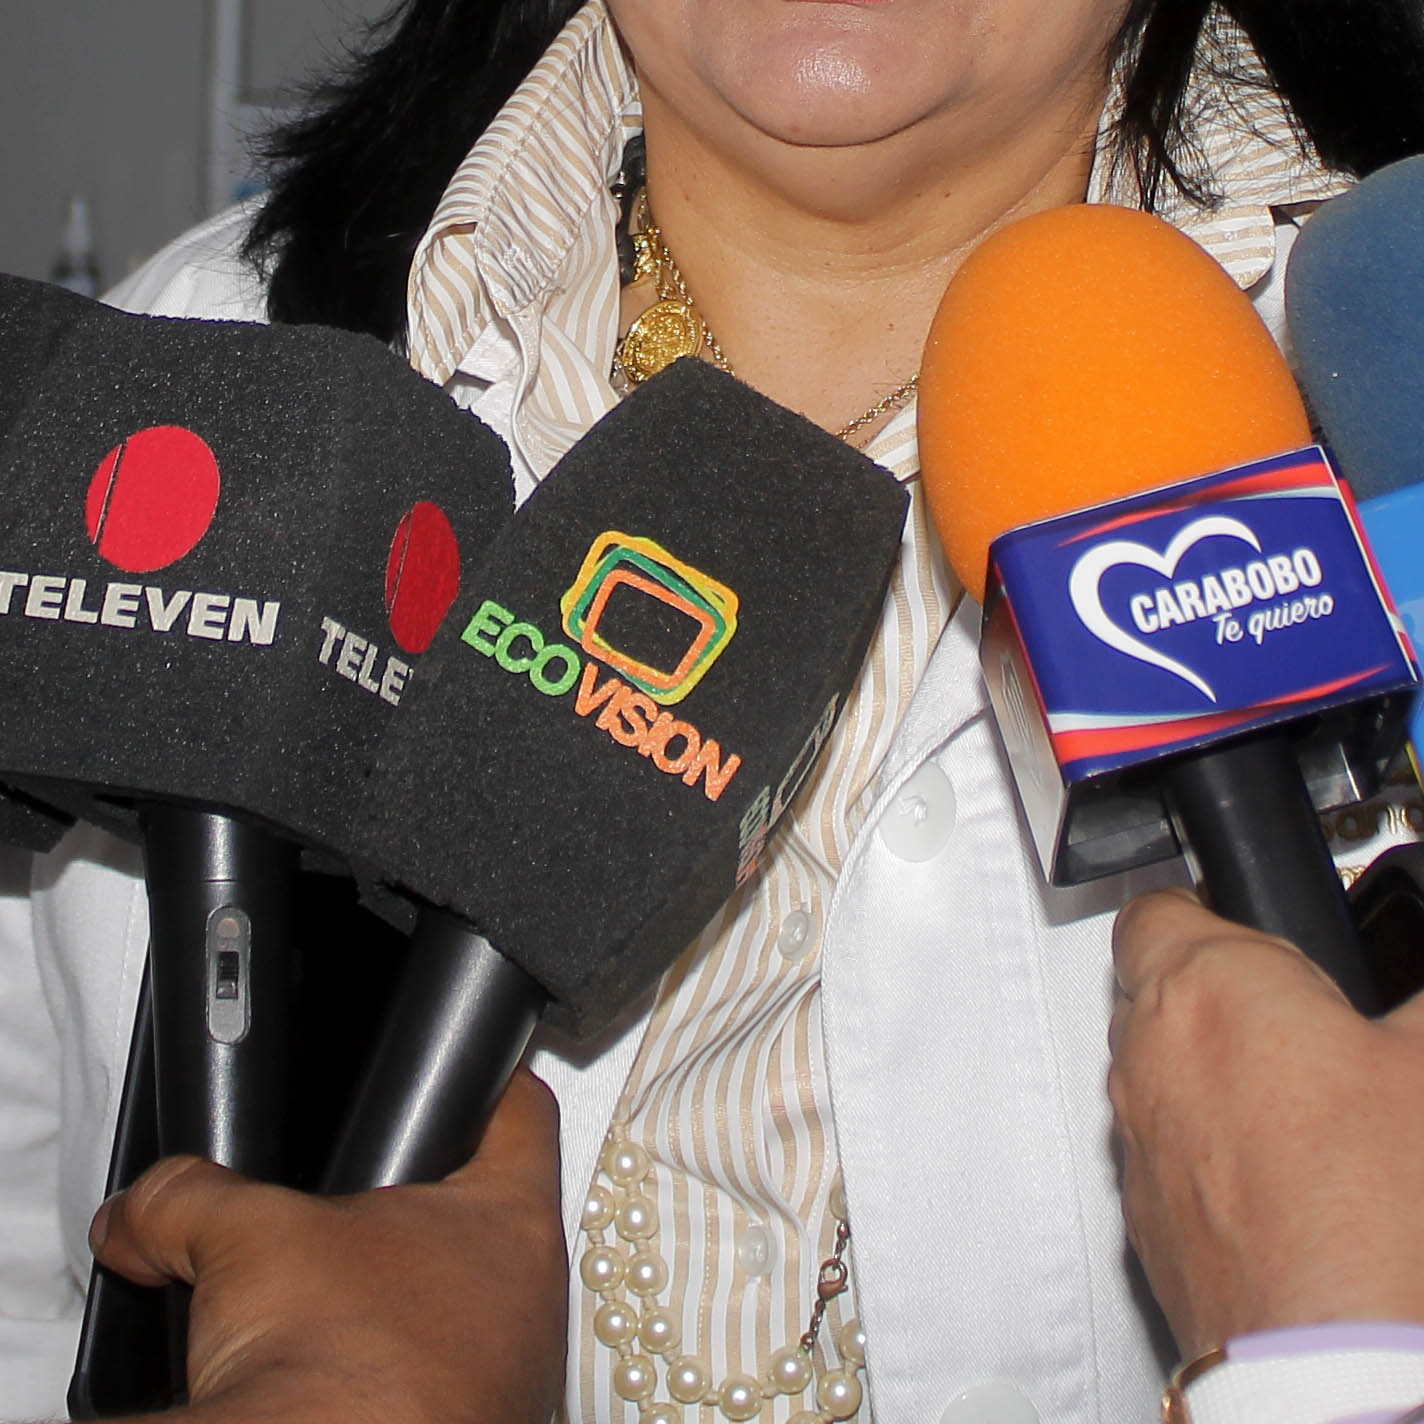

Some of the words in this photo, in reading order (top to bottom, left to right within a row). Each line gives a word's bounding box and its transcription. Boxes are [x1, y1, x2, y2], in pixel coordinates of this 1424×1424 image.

[1129, 548, 1324, 634] CARABOBO
[1212, 611, 1245, 645] Te
[1246, 593, 1336, 646] quiero
[318, 616, 415, 707] TELE
